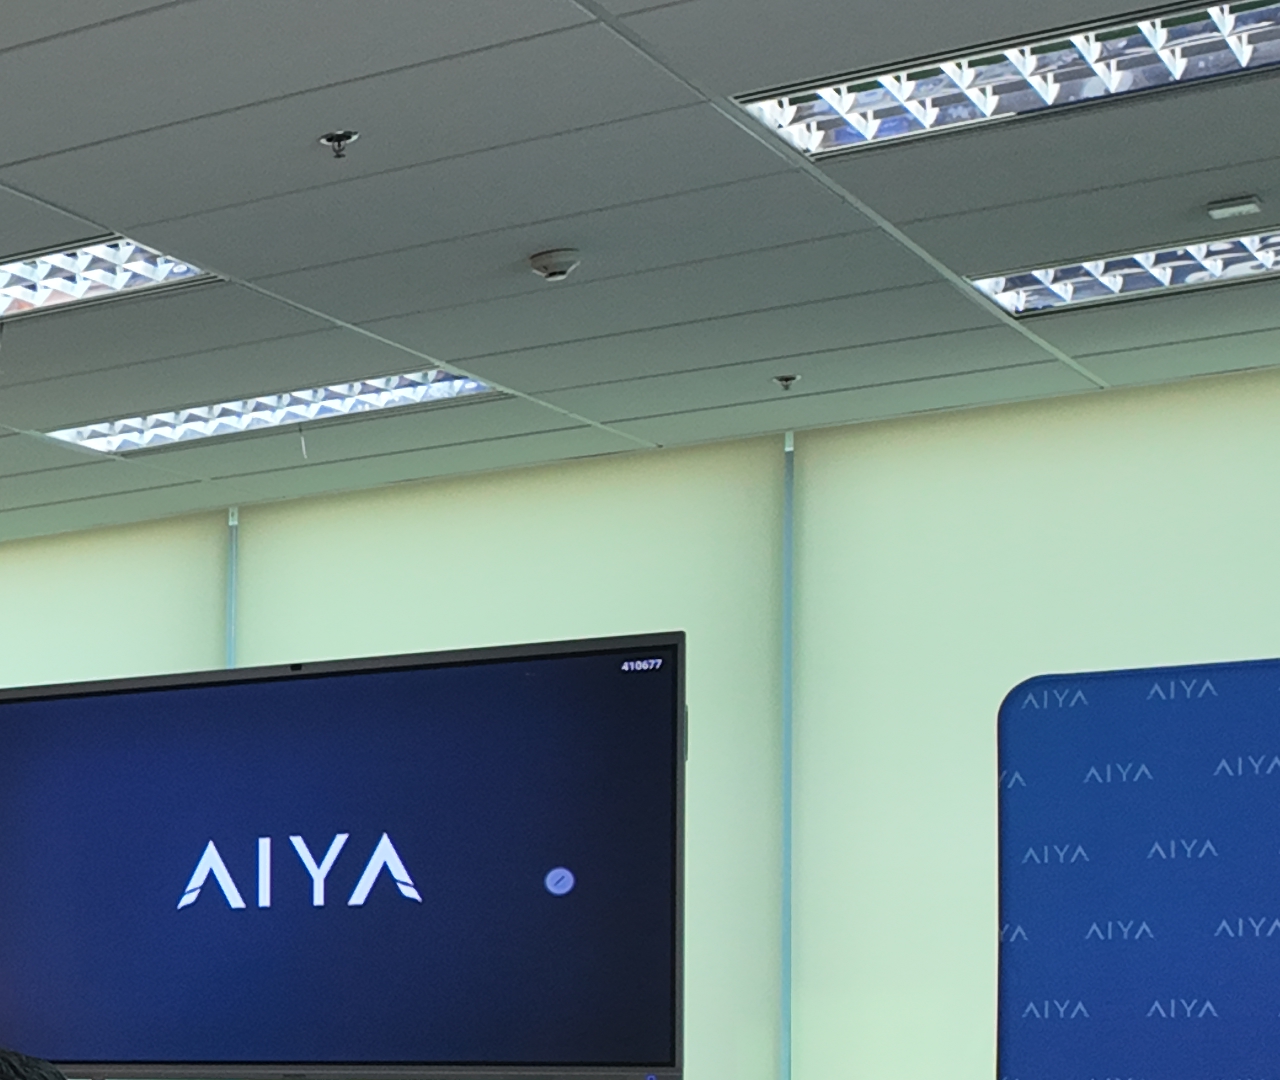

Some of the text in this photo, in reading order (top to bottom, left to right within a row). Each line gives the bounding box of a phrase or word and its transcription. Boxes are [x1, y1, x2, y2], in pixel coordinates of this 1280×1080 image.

[621, 658, 663, 671] 410677
[1021, 679, 1218, 709] AIYA AIYA
[1083, 763, 1154, 783] AIYA
[1021, 839, 1218, 864] AIYA AIYA
[177, 832, 423, 909] AIYA
[1085, 920, 1155, 940] AIYA
[1022, 999, 1219, 1018] AIYA AIYA
